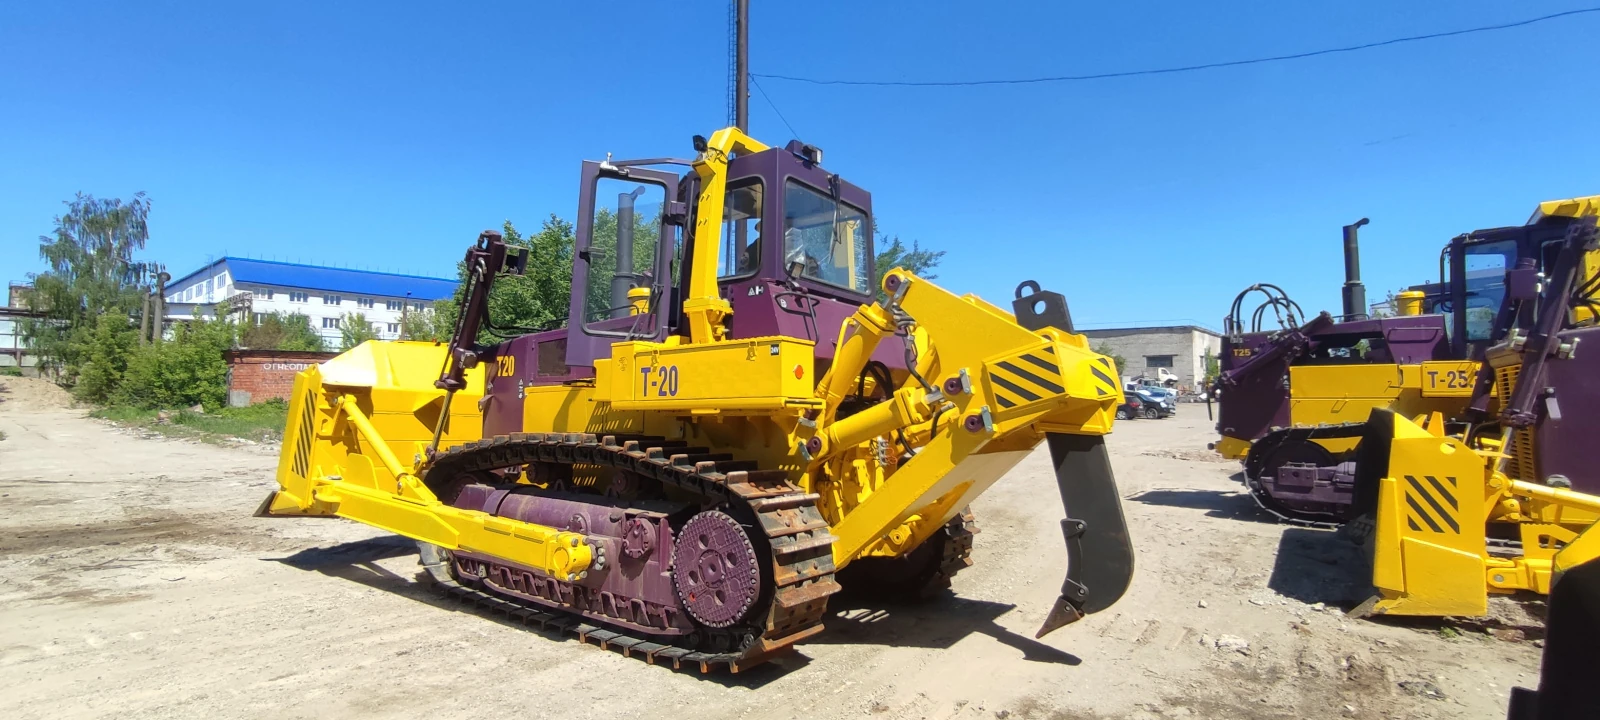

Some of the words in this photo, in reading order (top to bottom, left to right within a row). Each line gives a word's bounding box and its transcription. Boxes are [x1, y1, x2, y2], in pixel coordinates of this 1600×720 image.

[496, 355, 515, 377] T20
[640, 365, 678, 397] T-20
[1427, 370, 1474, 389] T-25.
